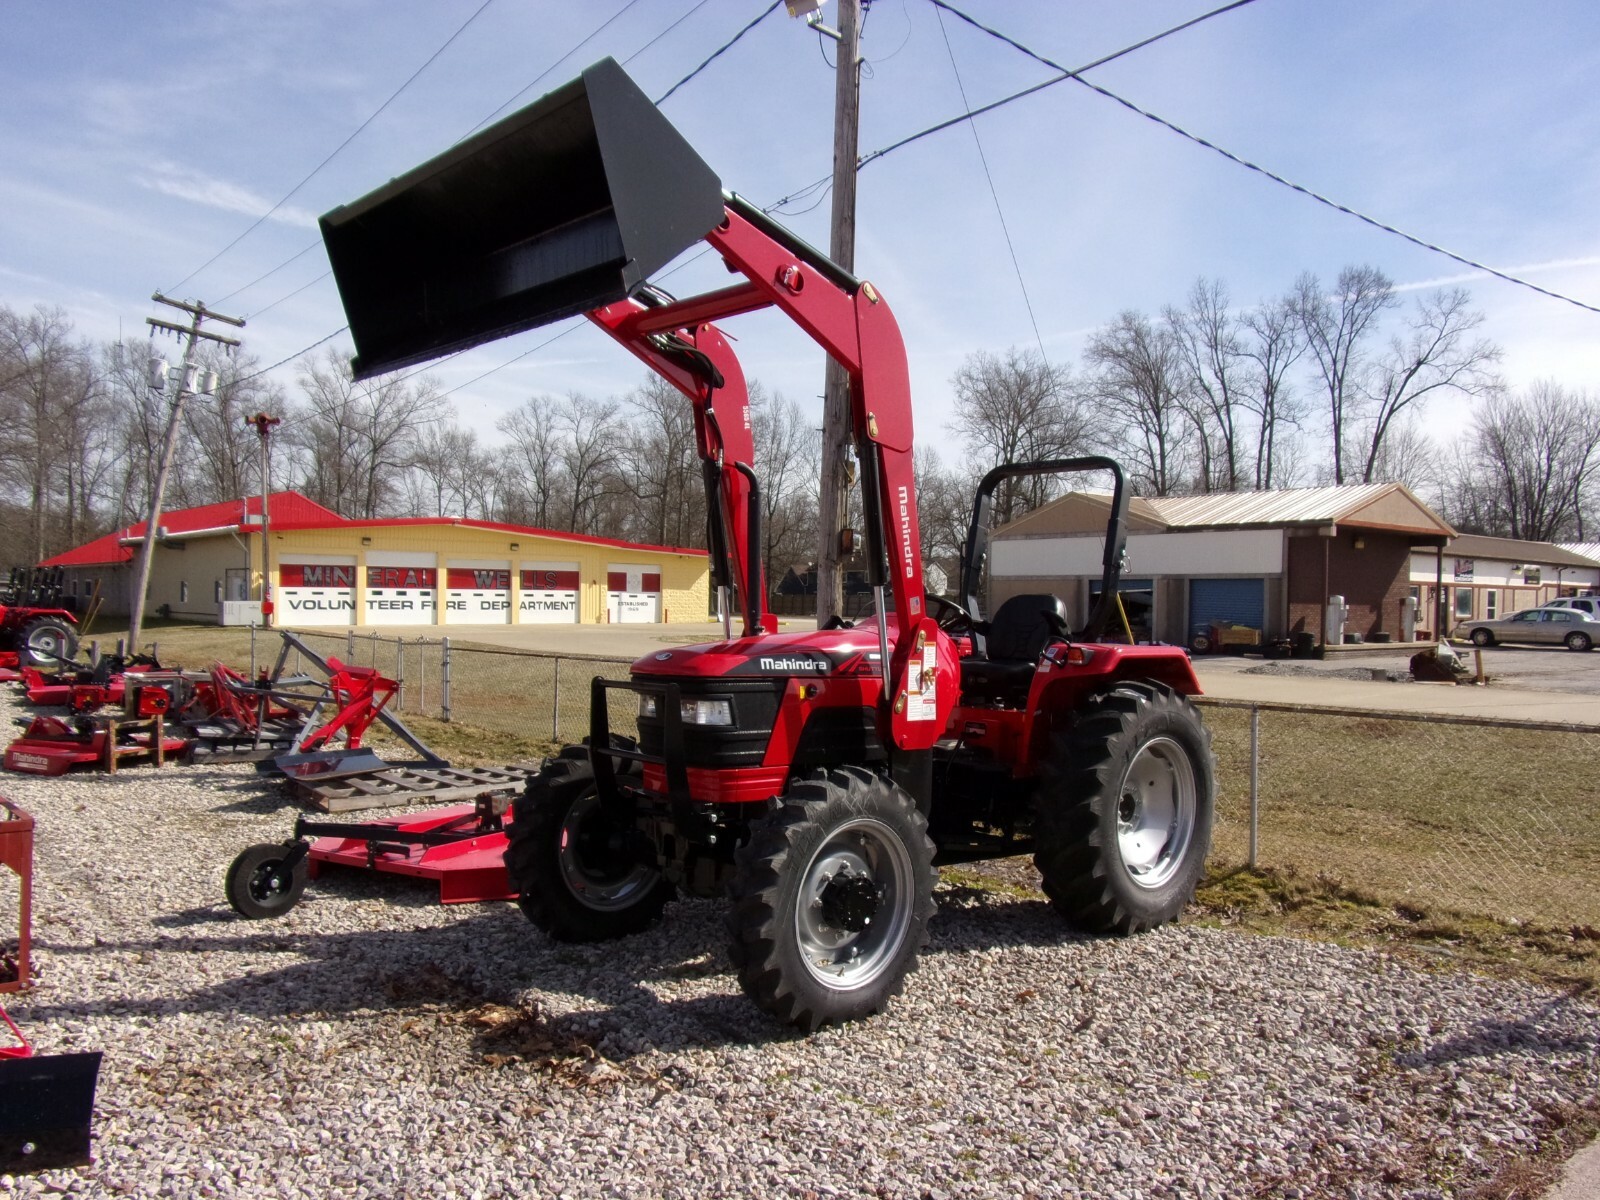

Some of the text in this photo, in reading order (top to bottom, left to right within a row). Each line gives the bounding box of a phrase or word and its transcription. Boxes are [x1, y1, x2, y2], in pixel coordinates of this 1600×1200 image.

[303, 565, 558, 590] MINERAL WELLS
[421, 600, 467, 611] FIRE
[480, 600, 577, 611] DEPARTMENT
[760, 658, 827, 670] Mahindra
[12, 752, 48, 764] Mahindra
